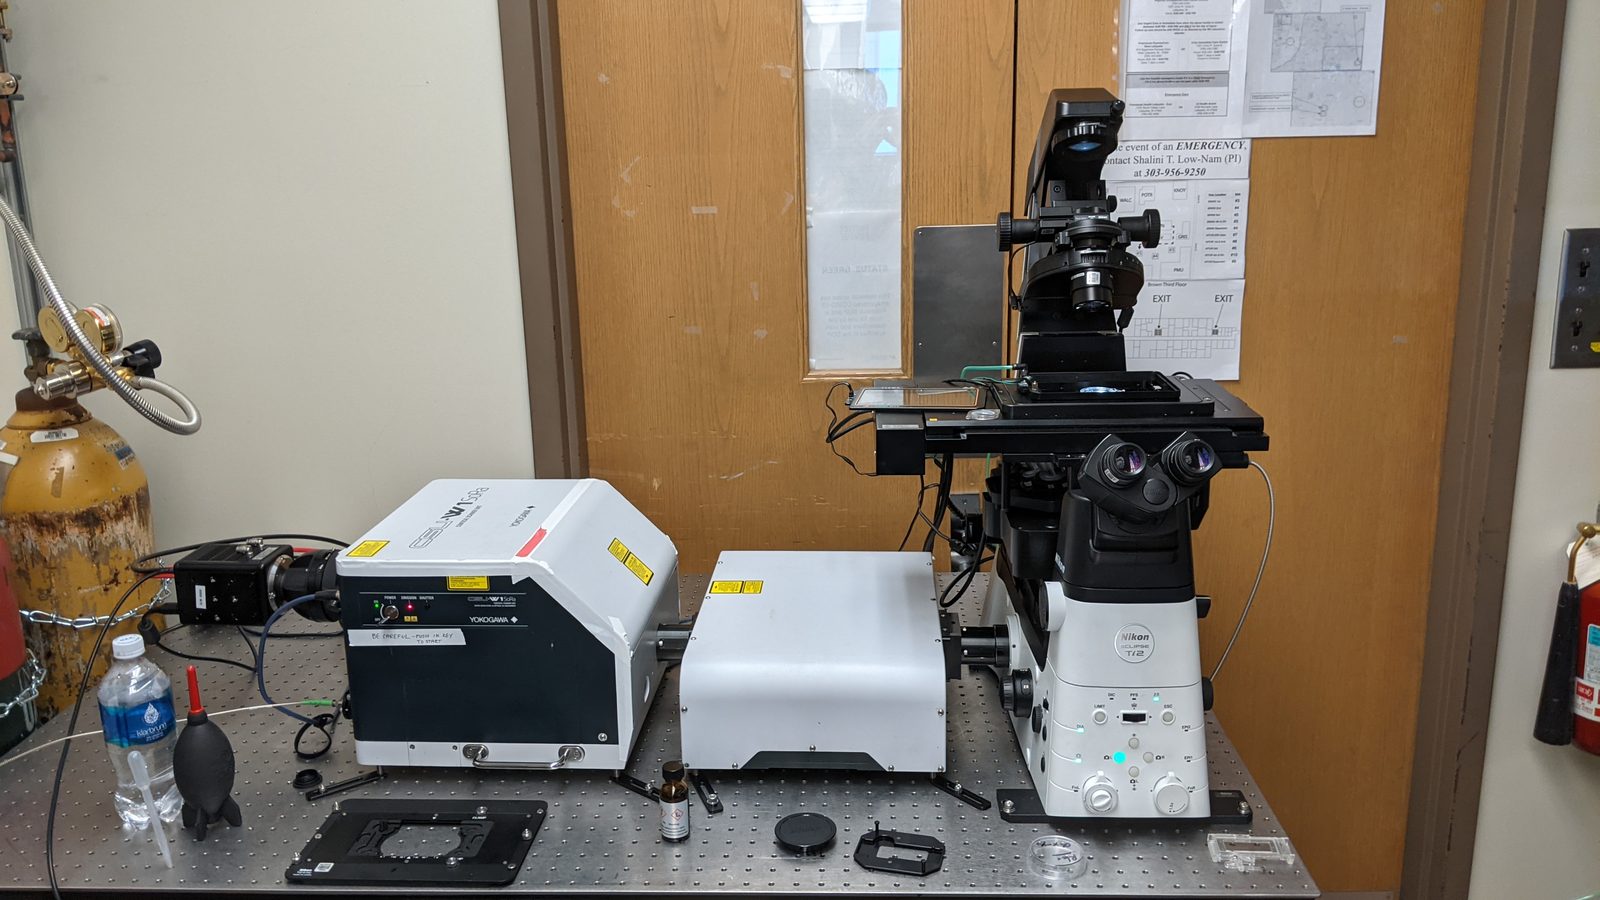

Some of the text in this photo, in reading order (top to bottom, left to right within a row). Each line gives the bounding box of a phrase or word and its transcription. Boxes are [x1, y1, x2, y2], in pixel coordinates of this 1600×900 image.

[1126, 143, 1149, 151] event
[1151, 142, 1161, 151] of
[1176, 141, 1247, 151] EMERGENCY,
[1104, 156, 1130, 165] ontact
[1133, 155, 1164, 164] Shalini
[1179, 155, 1222, 164] Low-Nam
[1224, 154, 1242, 164] (PI)
[1144, 168, 1206, 177] 303-956-9250
